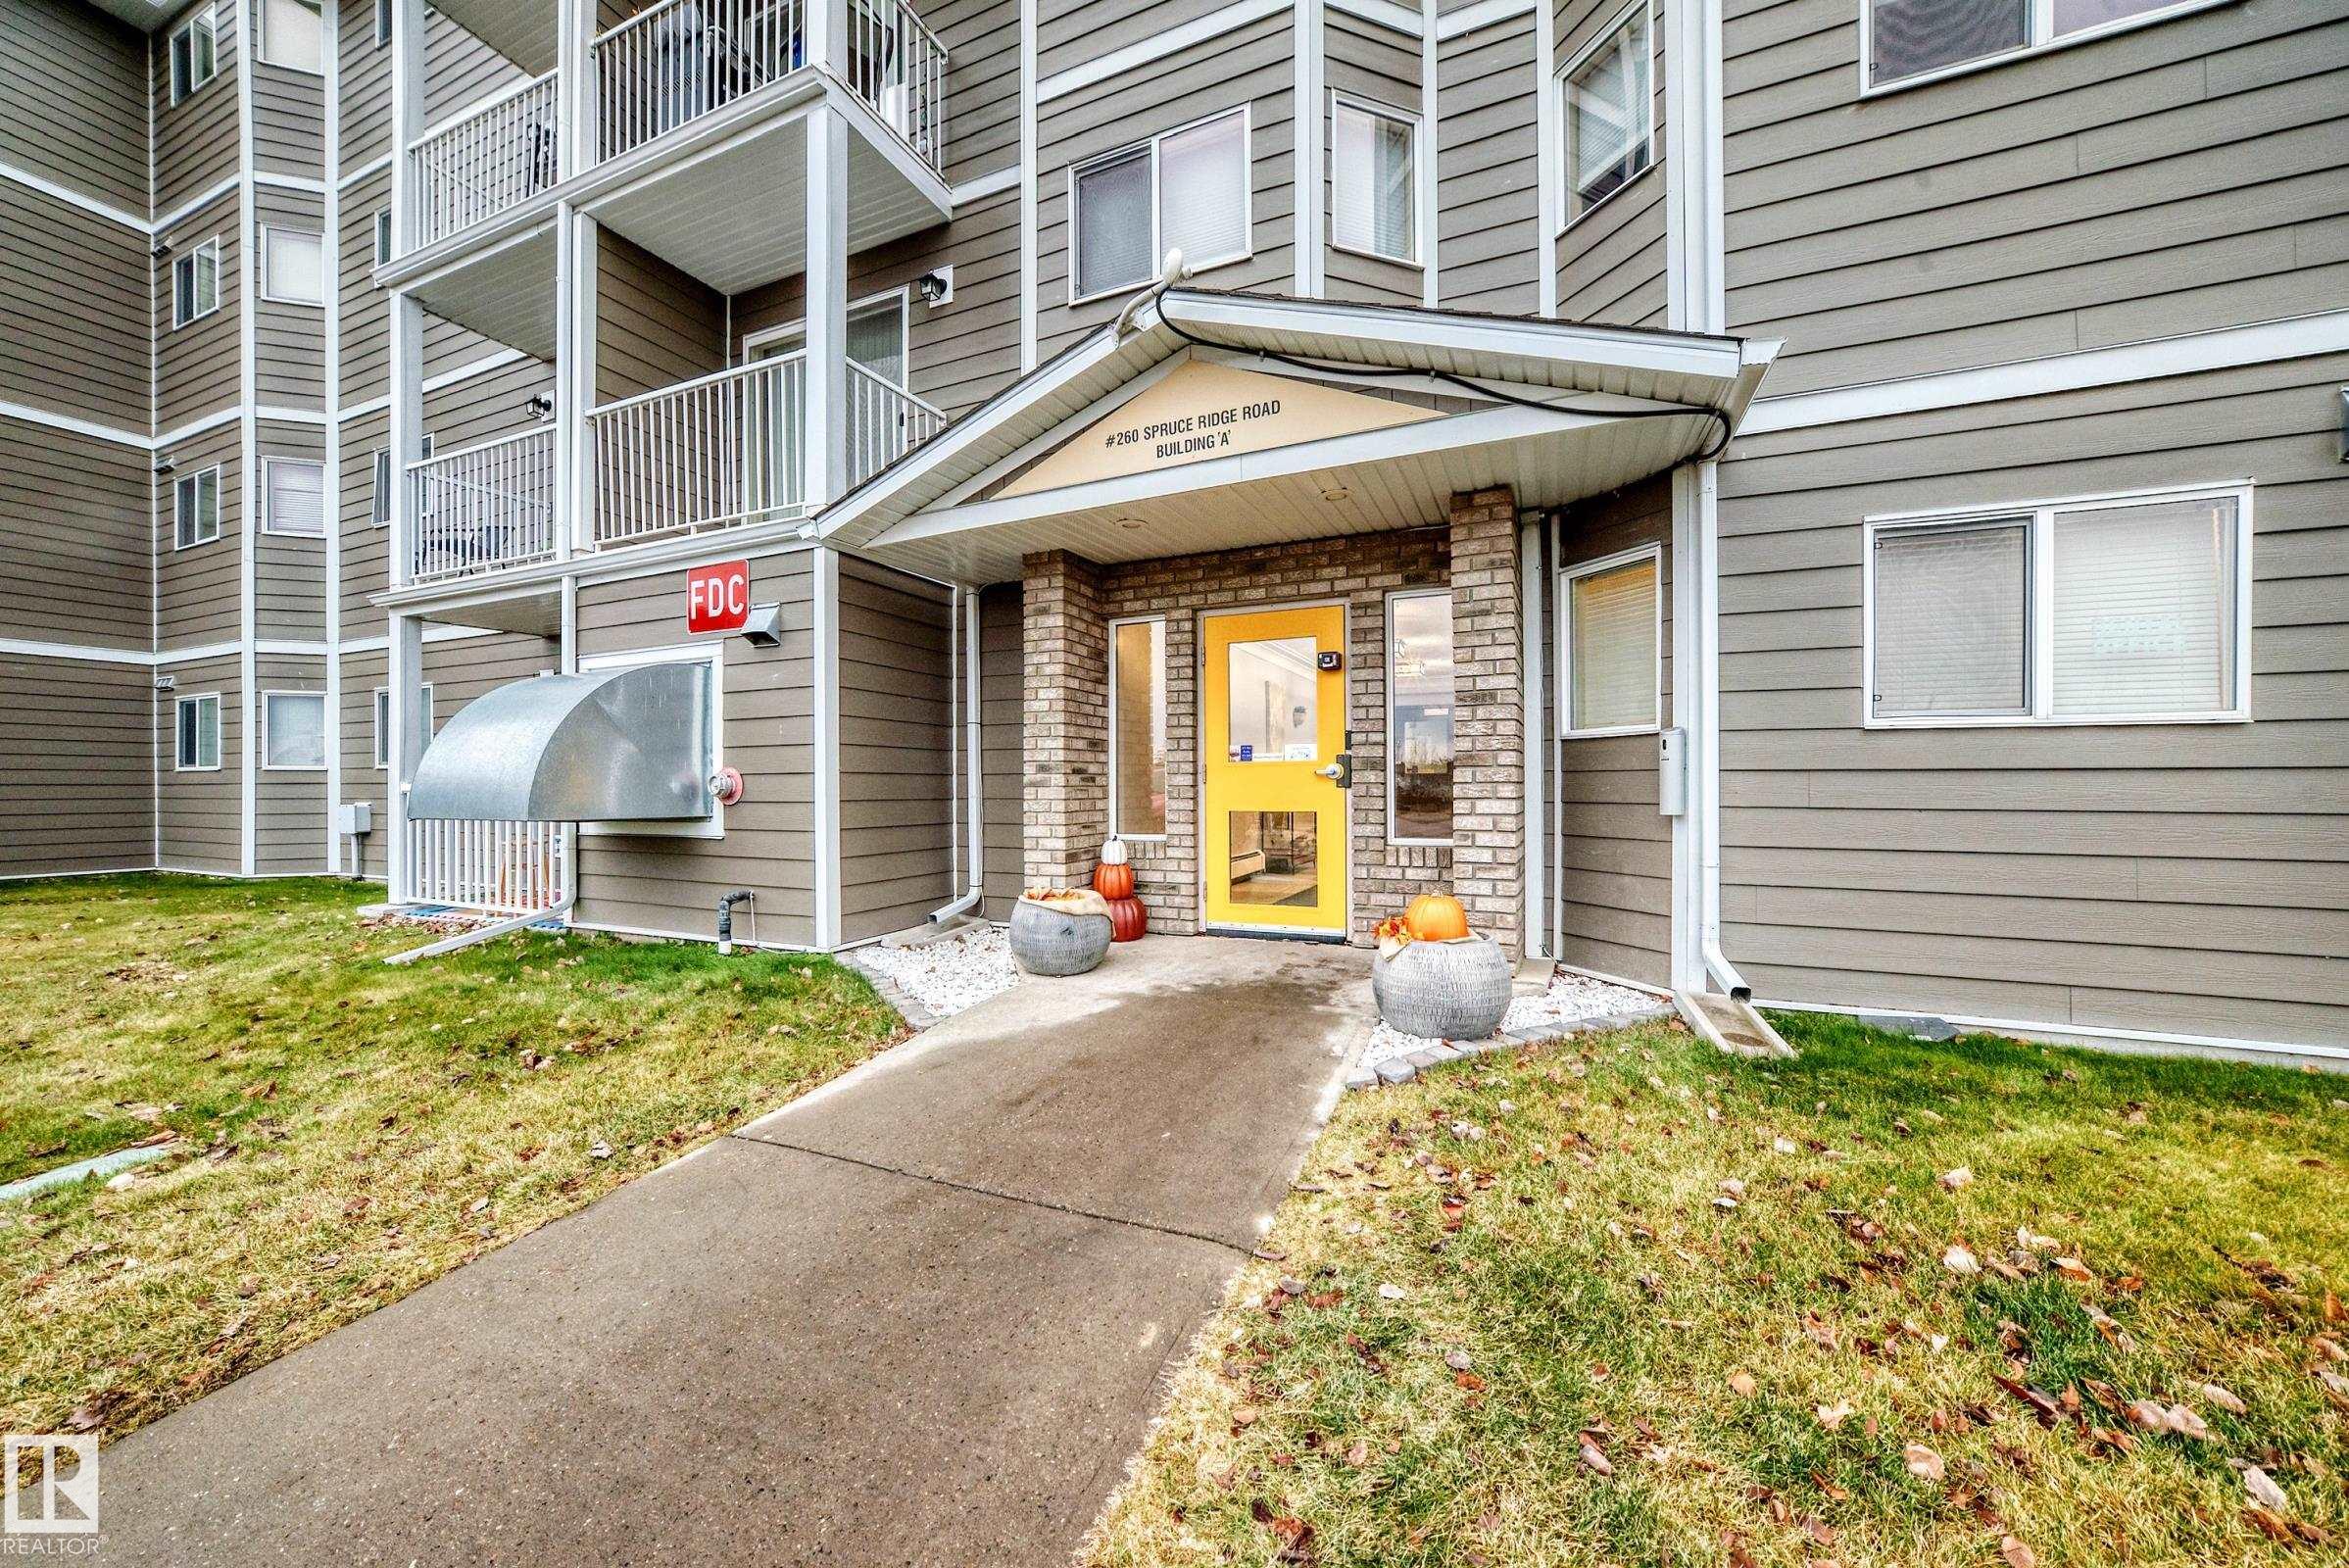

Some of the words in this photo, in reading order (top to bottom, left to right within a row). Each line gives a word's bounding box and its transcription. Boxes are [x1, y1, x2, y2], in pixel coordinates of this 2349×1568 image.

[1105, 430, 1139, 448] #260
[1144, 417, 1193, 440] SPRUCE
[1198, 409, 1238, 428] RIDGE
[1243, 400, 1281, 420] ROAD
[1156, 439, 1215, 459] BUILDING
[690, 573, 745, 619] FDC
